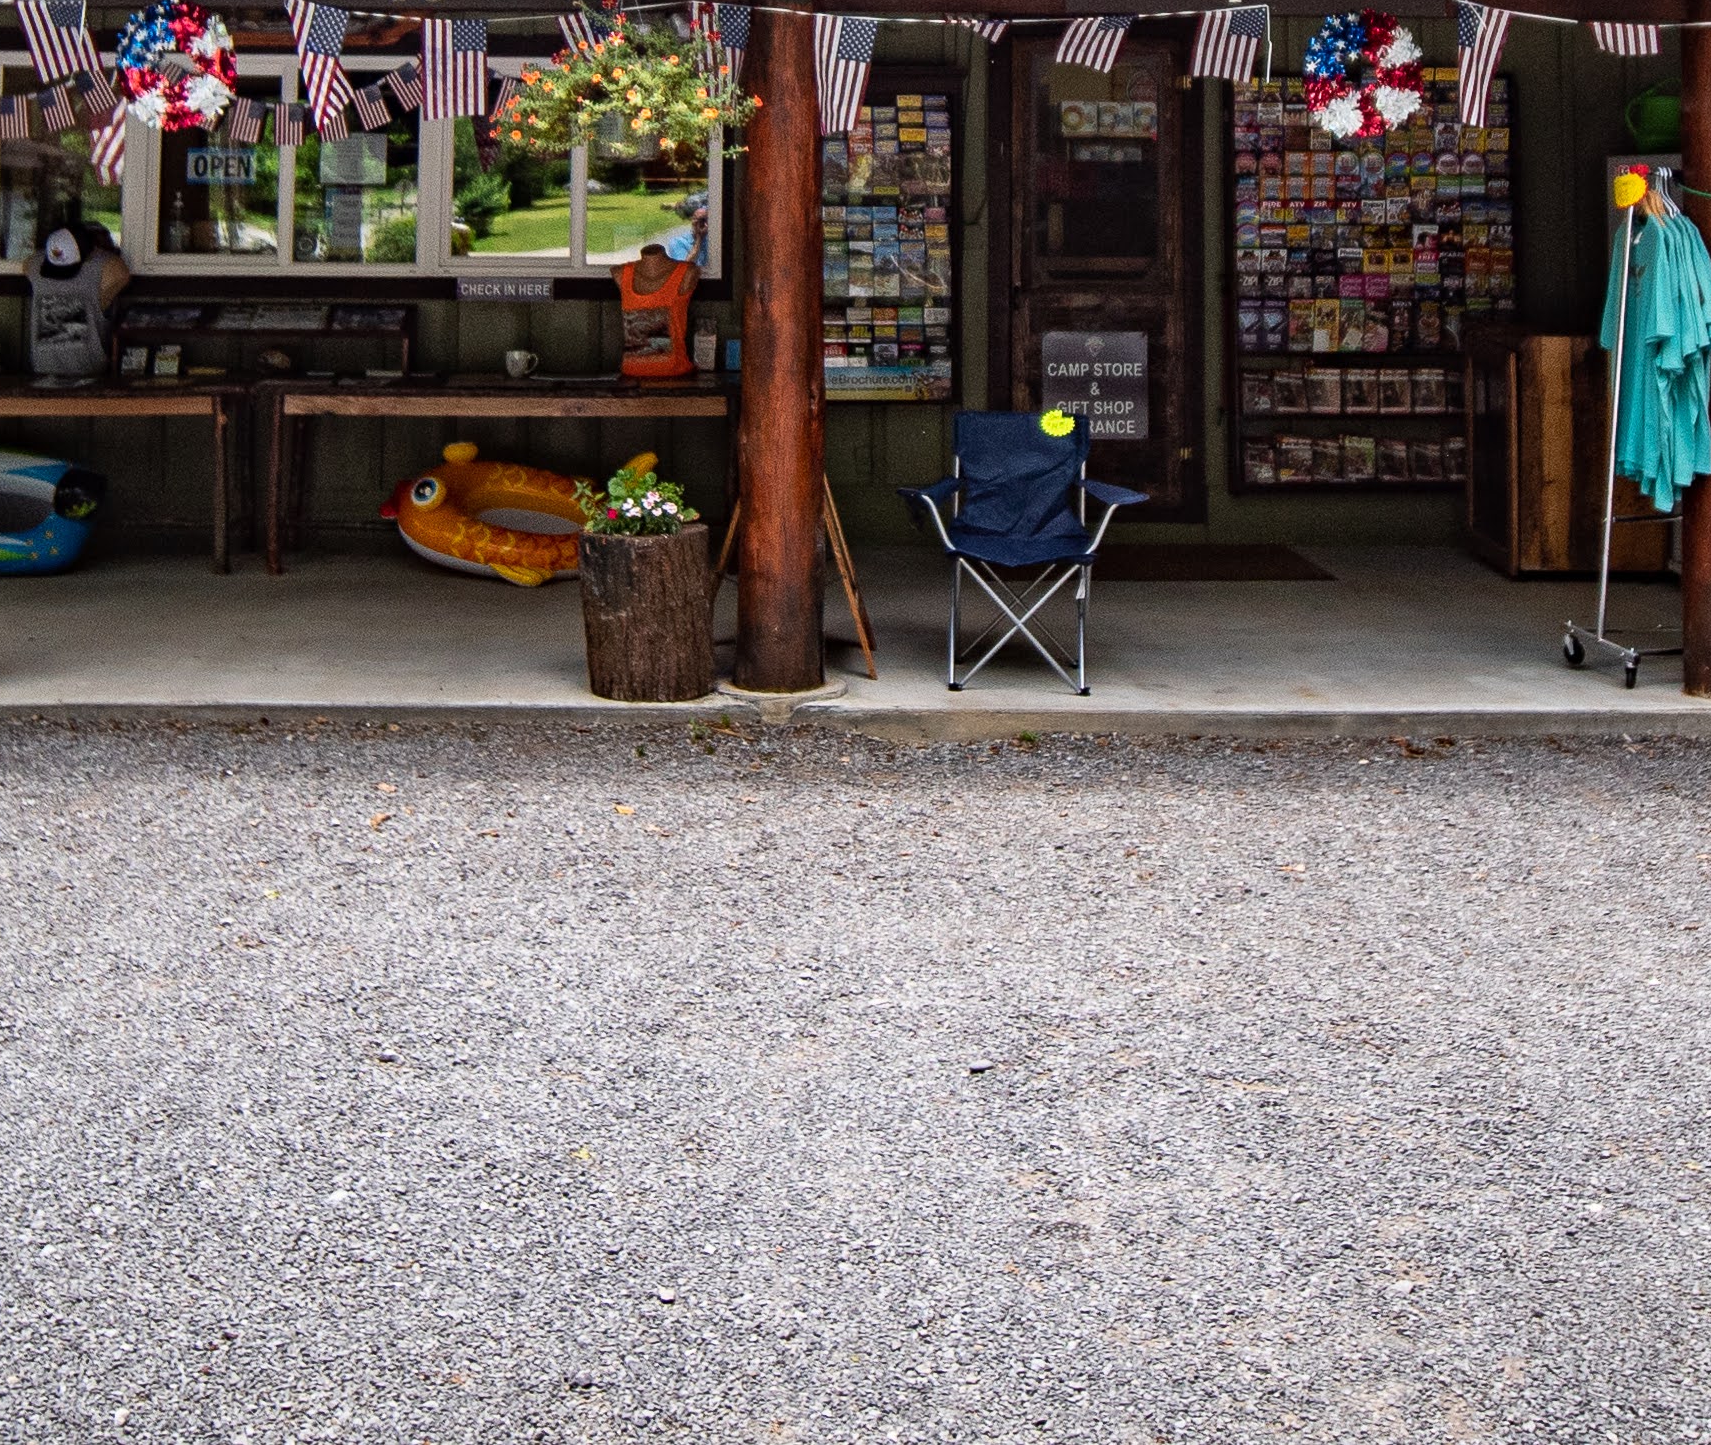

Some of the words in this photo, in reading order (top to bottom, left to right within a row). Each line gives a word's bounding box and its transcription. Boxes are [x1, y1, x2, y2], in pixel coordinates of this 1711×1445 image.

[194, 154, 252, 178] OPEN
[461, 284, 502, 296] CHECK
[504, 284, 516, 296] IN
[518, 284, 550, 296] HERE
[1047, 363, 1089, 377] CAMP
[1093, 363, 1143, 377] STORE
[1090, 381, 1101, 395] &
[1056, 401, 1089, 415] GIFT
[1093, 401, 1135, 415] SHOP
